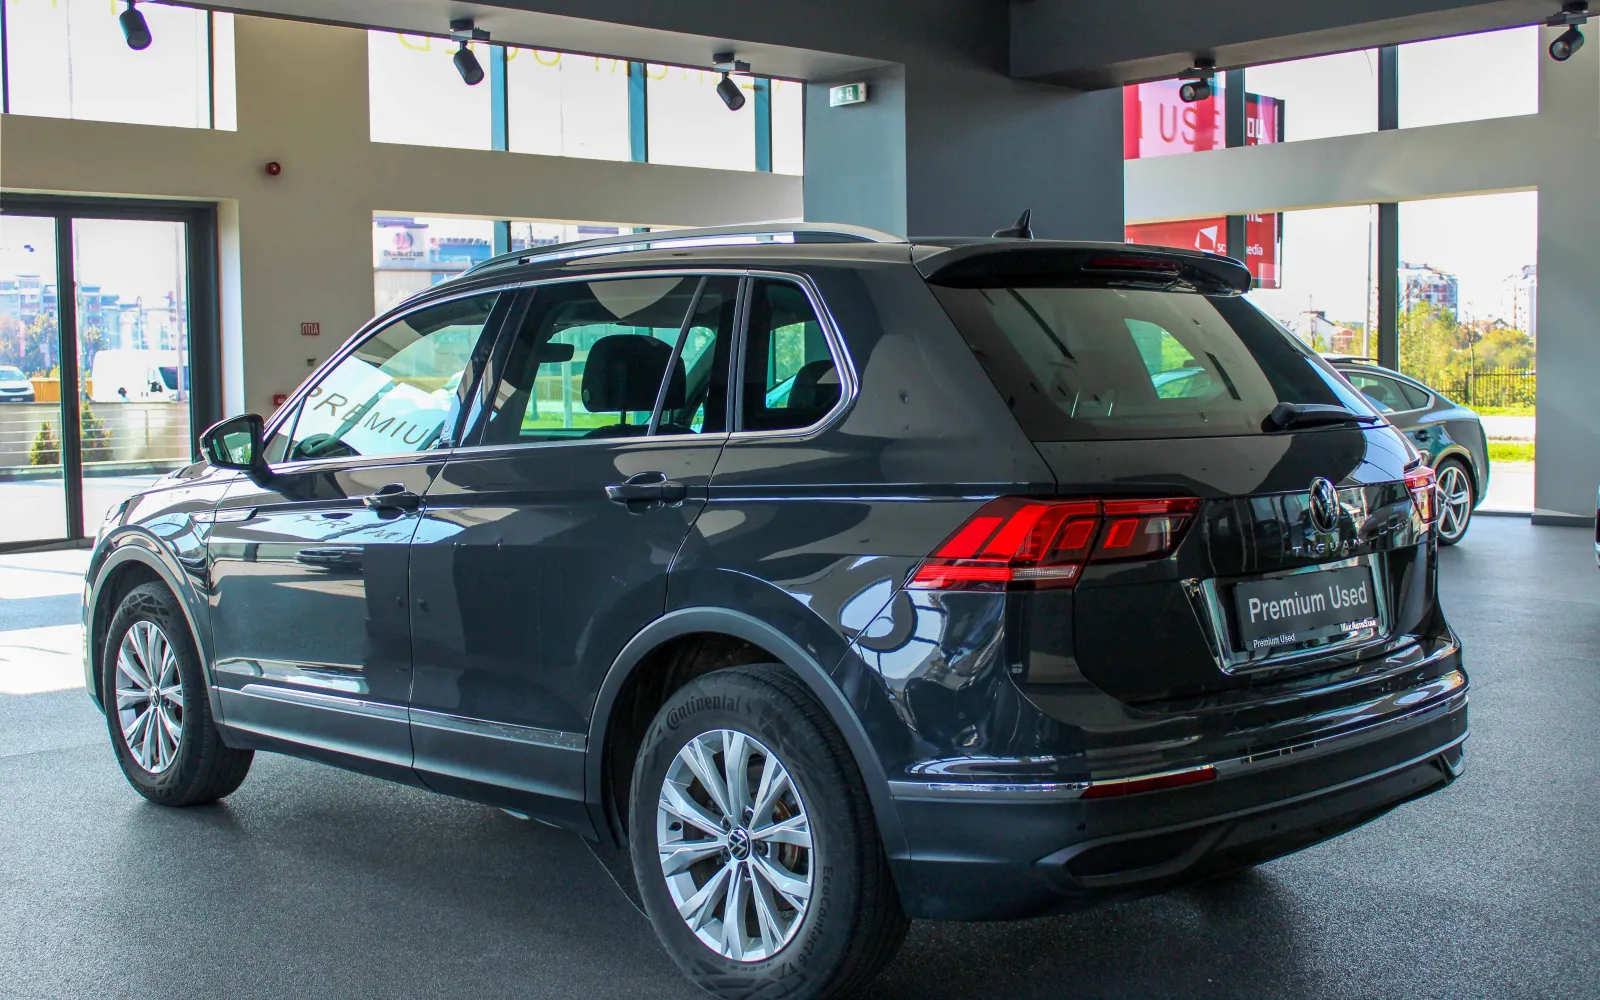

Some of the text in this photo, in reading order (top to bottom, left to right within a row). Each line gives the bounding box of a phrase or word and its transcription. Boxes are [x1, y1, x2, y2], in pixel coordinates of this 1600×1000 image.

[1248, 580, 1368, 623] Premium Used
[1253, 633, 1296, 649] Premium Used
[666, 695, 740, 731] Continental
